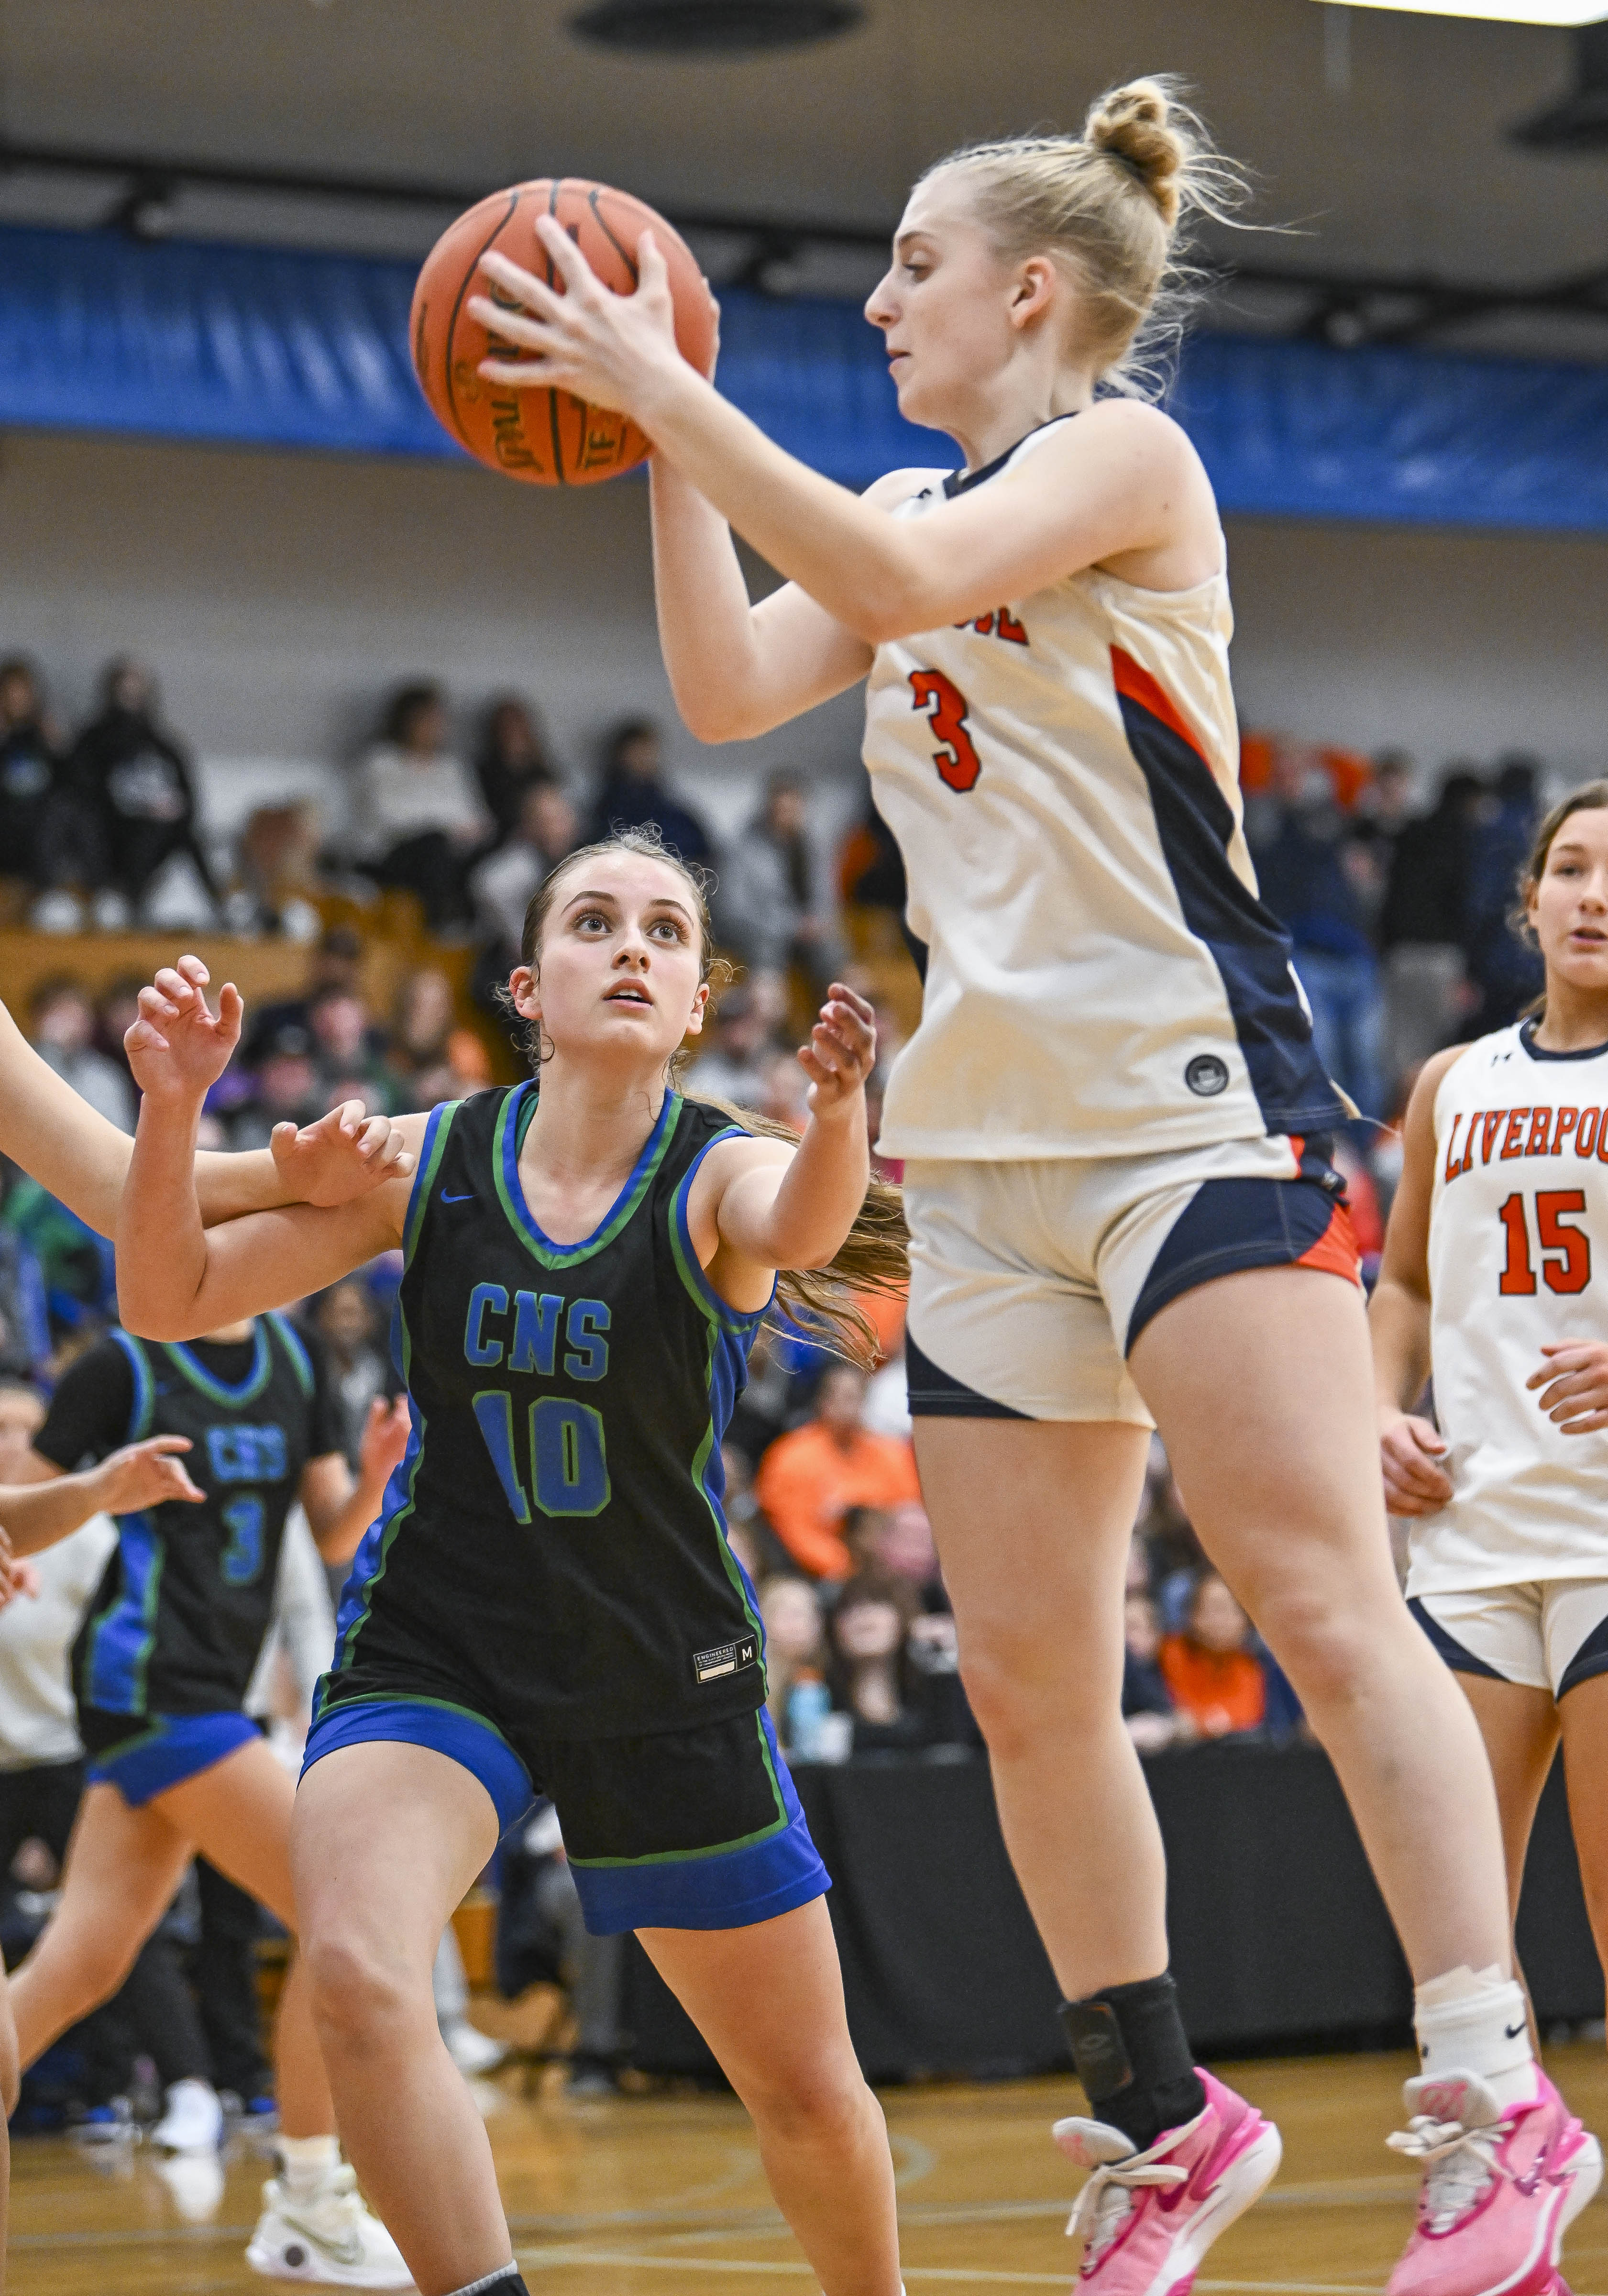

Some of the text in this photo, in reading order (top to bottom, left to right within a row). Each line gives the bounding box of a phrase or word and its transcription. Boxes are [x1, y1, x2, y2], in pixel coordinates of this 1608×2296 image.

[908, 668, 982, 794] 3
[1498, 1189, 1591, 1296] 15
[464, 1282, 612, 1382] CNS
[471, 1390, 612, 1525] 10
[697, 1646, 734, 1661] ENGINEERED
[742, 1646, 752, 1661] M
